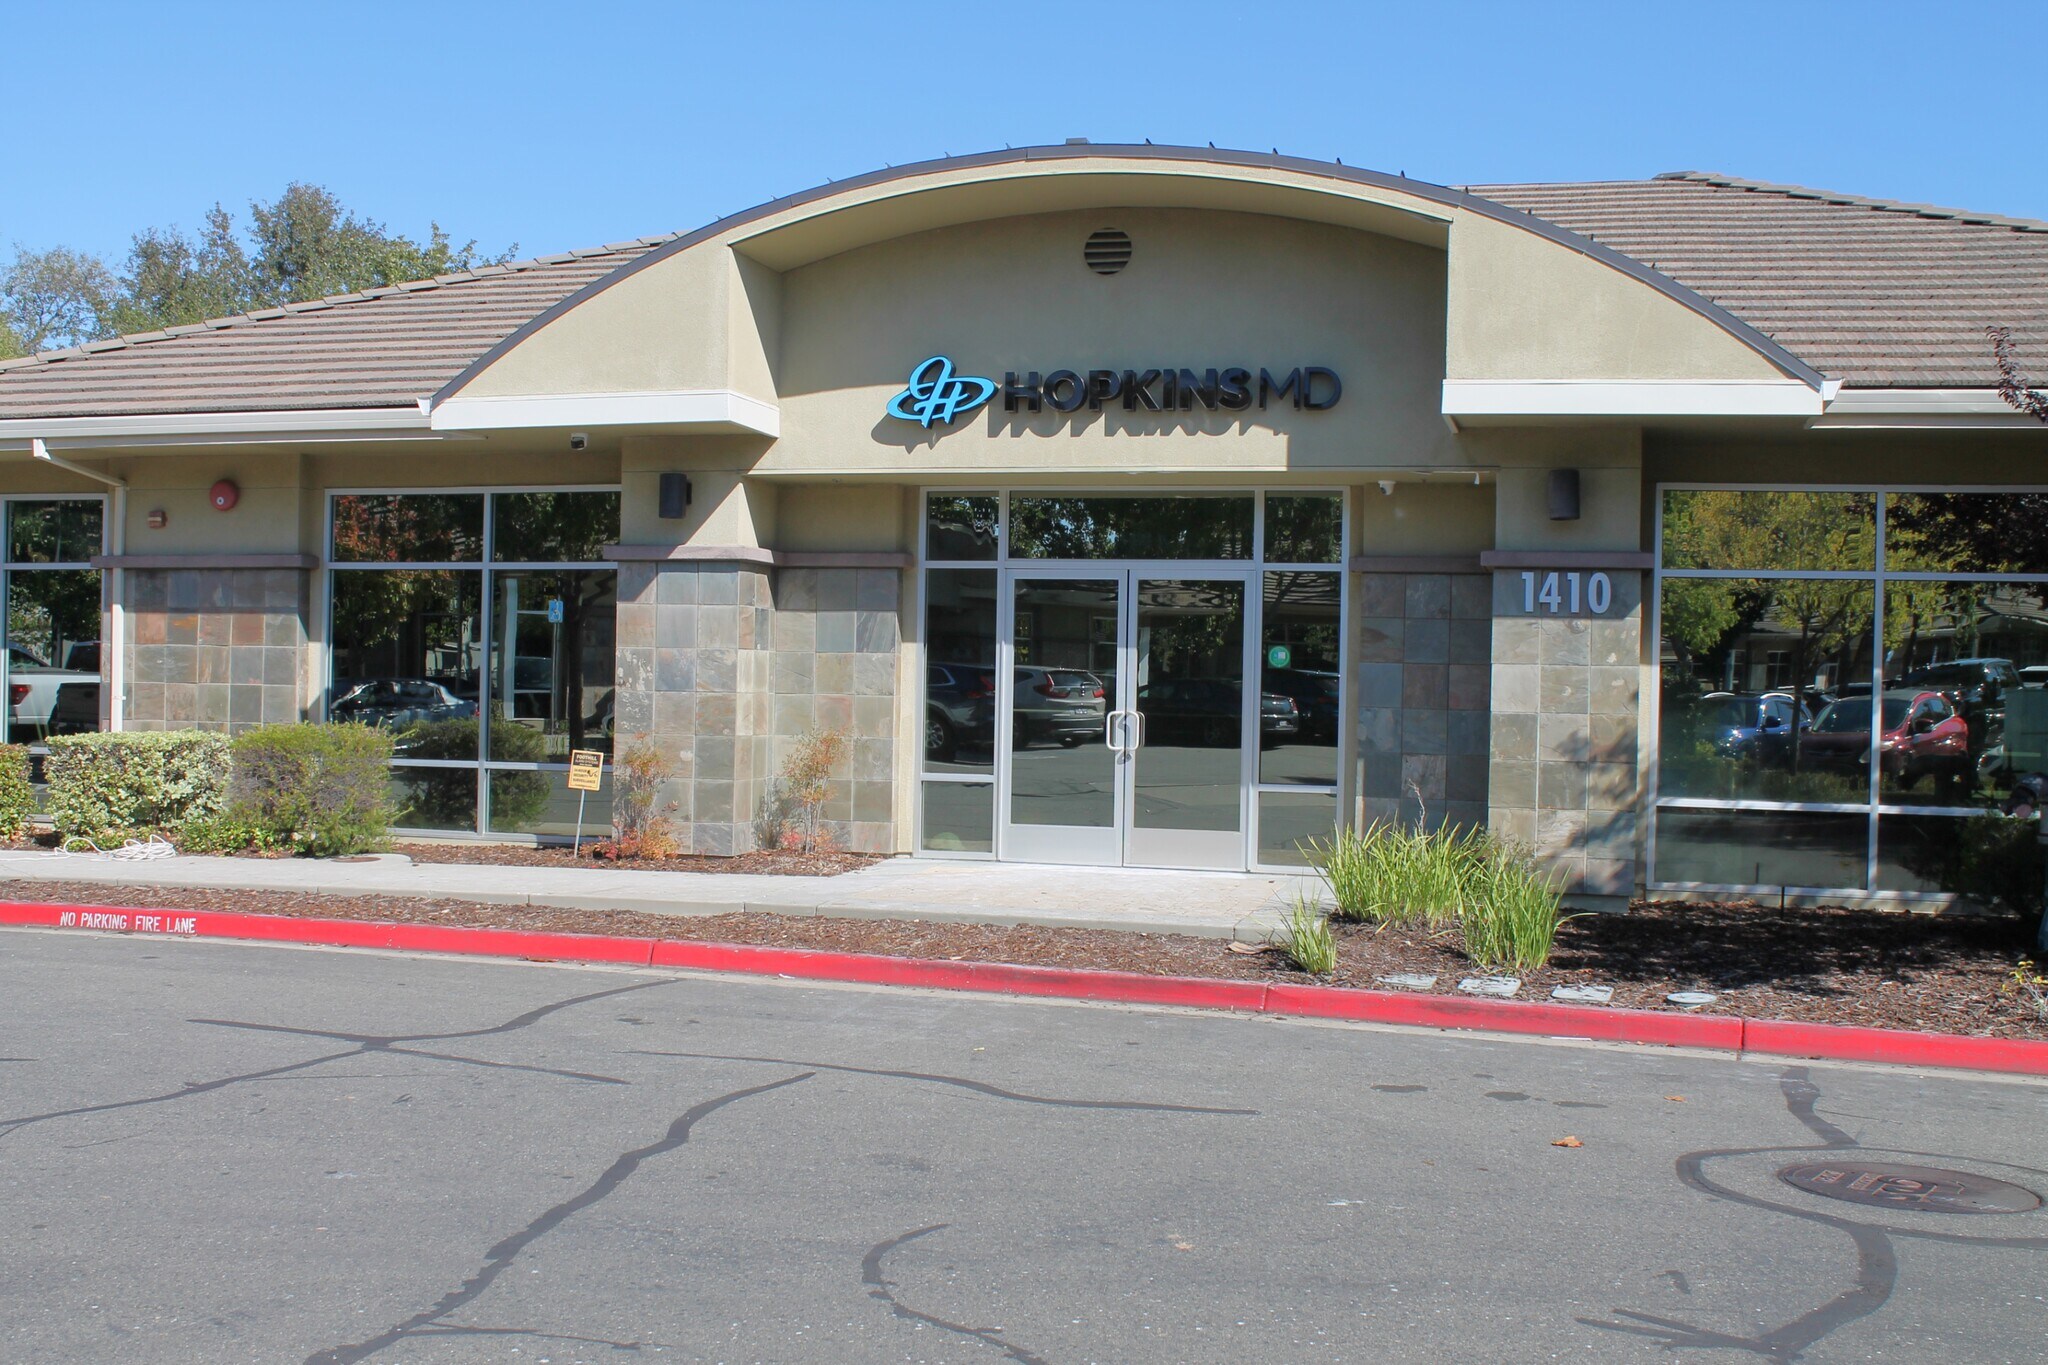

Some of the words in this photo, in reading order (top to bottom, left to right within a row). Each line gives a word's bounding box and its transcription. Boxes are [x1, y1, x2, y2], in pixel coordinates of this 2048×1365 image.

[1521, 571, 1612, 614] 1410
[60, 911, 76, 927] NO
[80, 912, 127, 930] PARKING
[135, 915, 161, 932] FIRE
[166, 917, 197, 934] LANE
